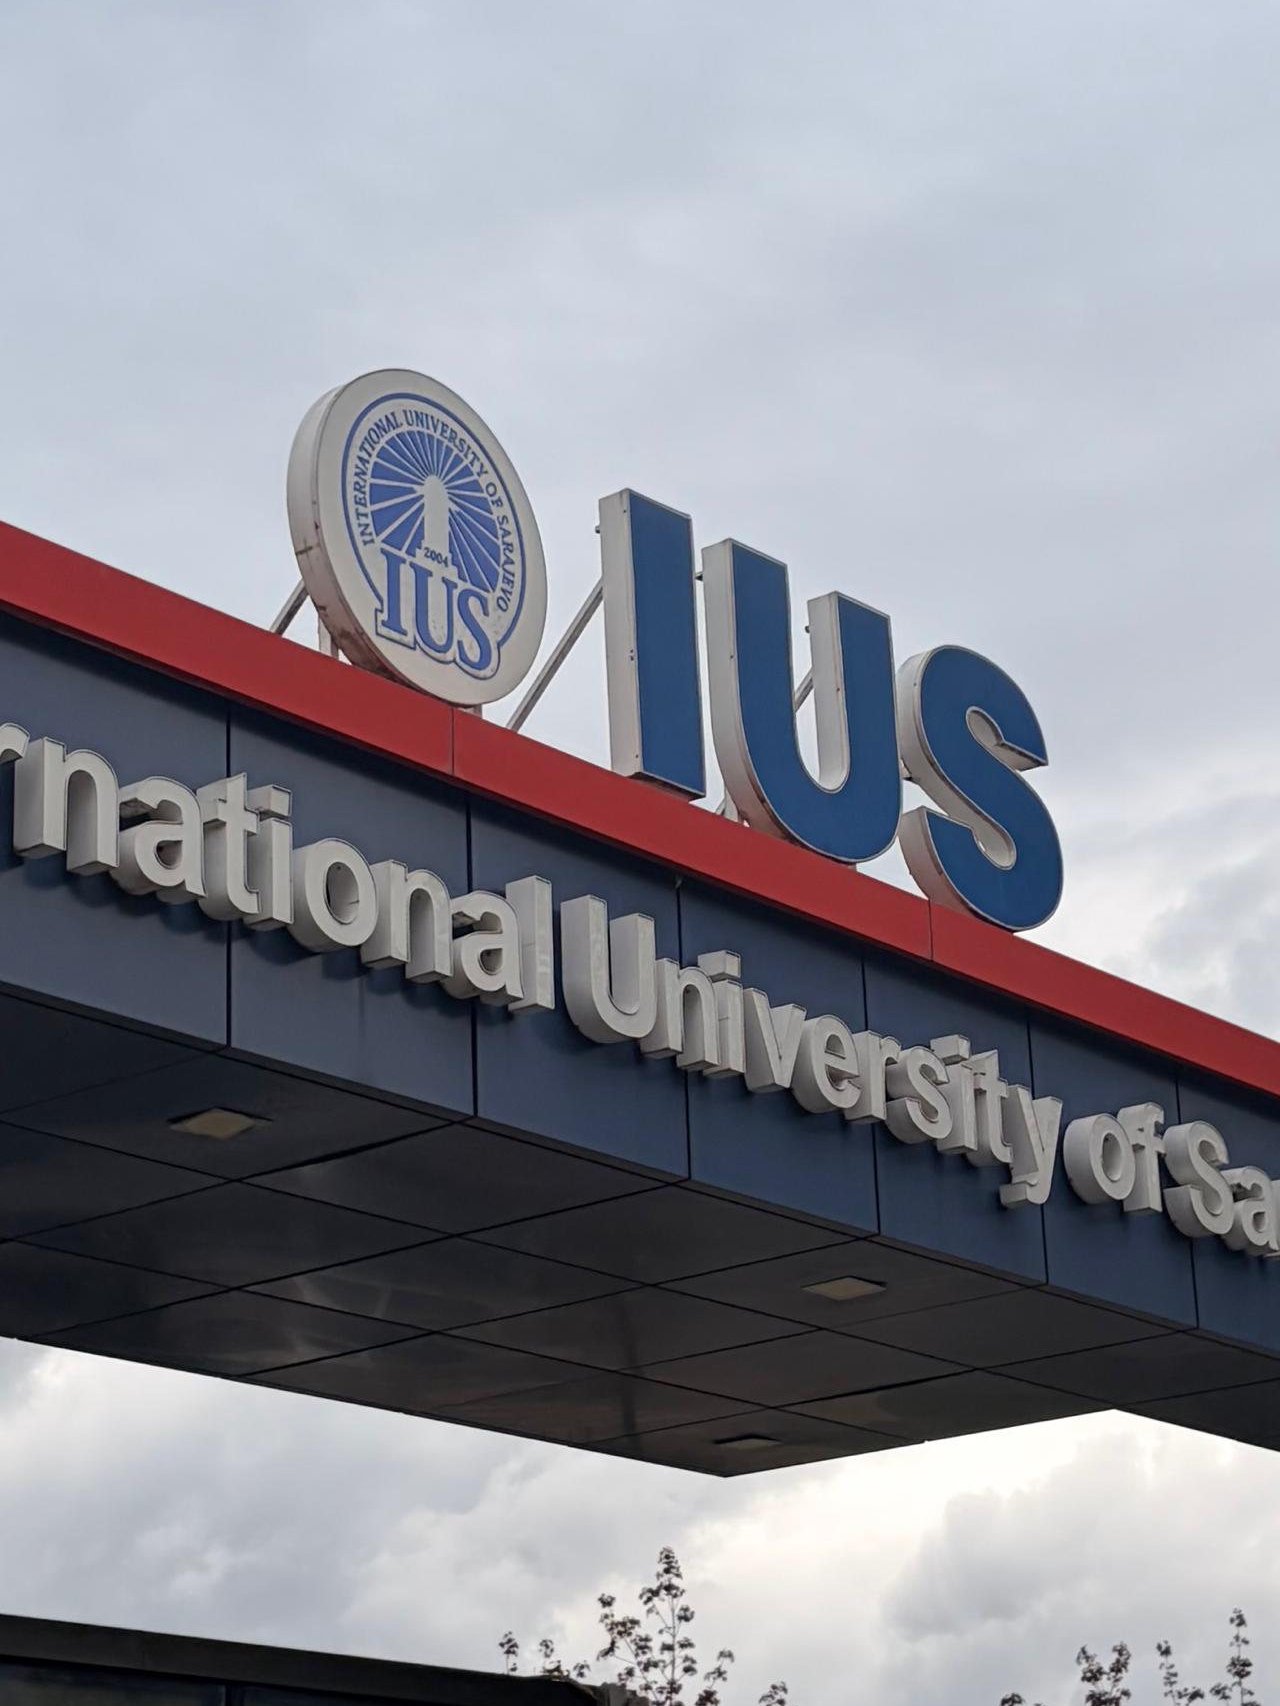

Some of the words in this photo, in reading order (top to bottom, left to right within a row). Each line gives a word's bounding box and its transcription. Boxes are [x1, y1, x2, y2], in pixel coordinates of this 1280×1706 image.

[353, 410, 402, 547] INTERNATIONAL
[402, 409, 489, 478] UNIVERSITY
[484, 481, 503, 508] OF
[496, 514, 515, 613] SARAJEVO
[380, 547, 492, 672] IUS
[423, 547, 450, 568] 2004
[599, 488, 1063, 932] IUS
[560, 894, 1063, 1208] University
[1063, 1101, 1166, 1214] of
